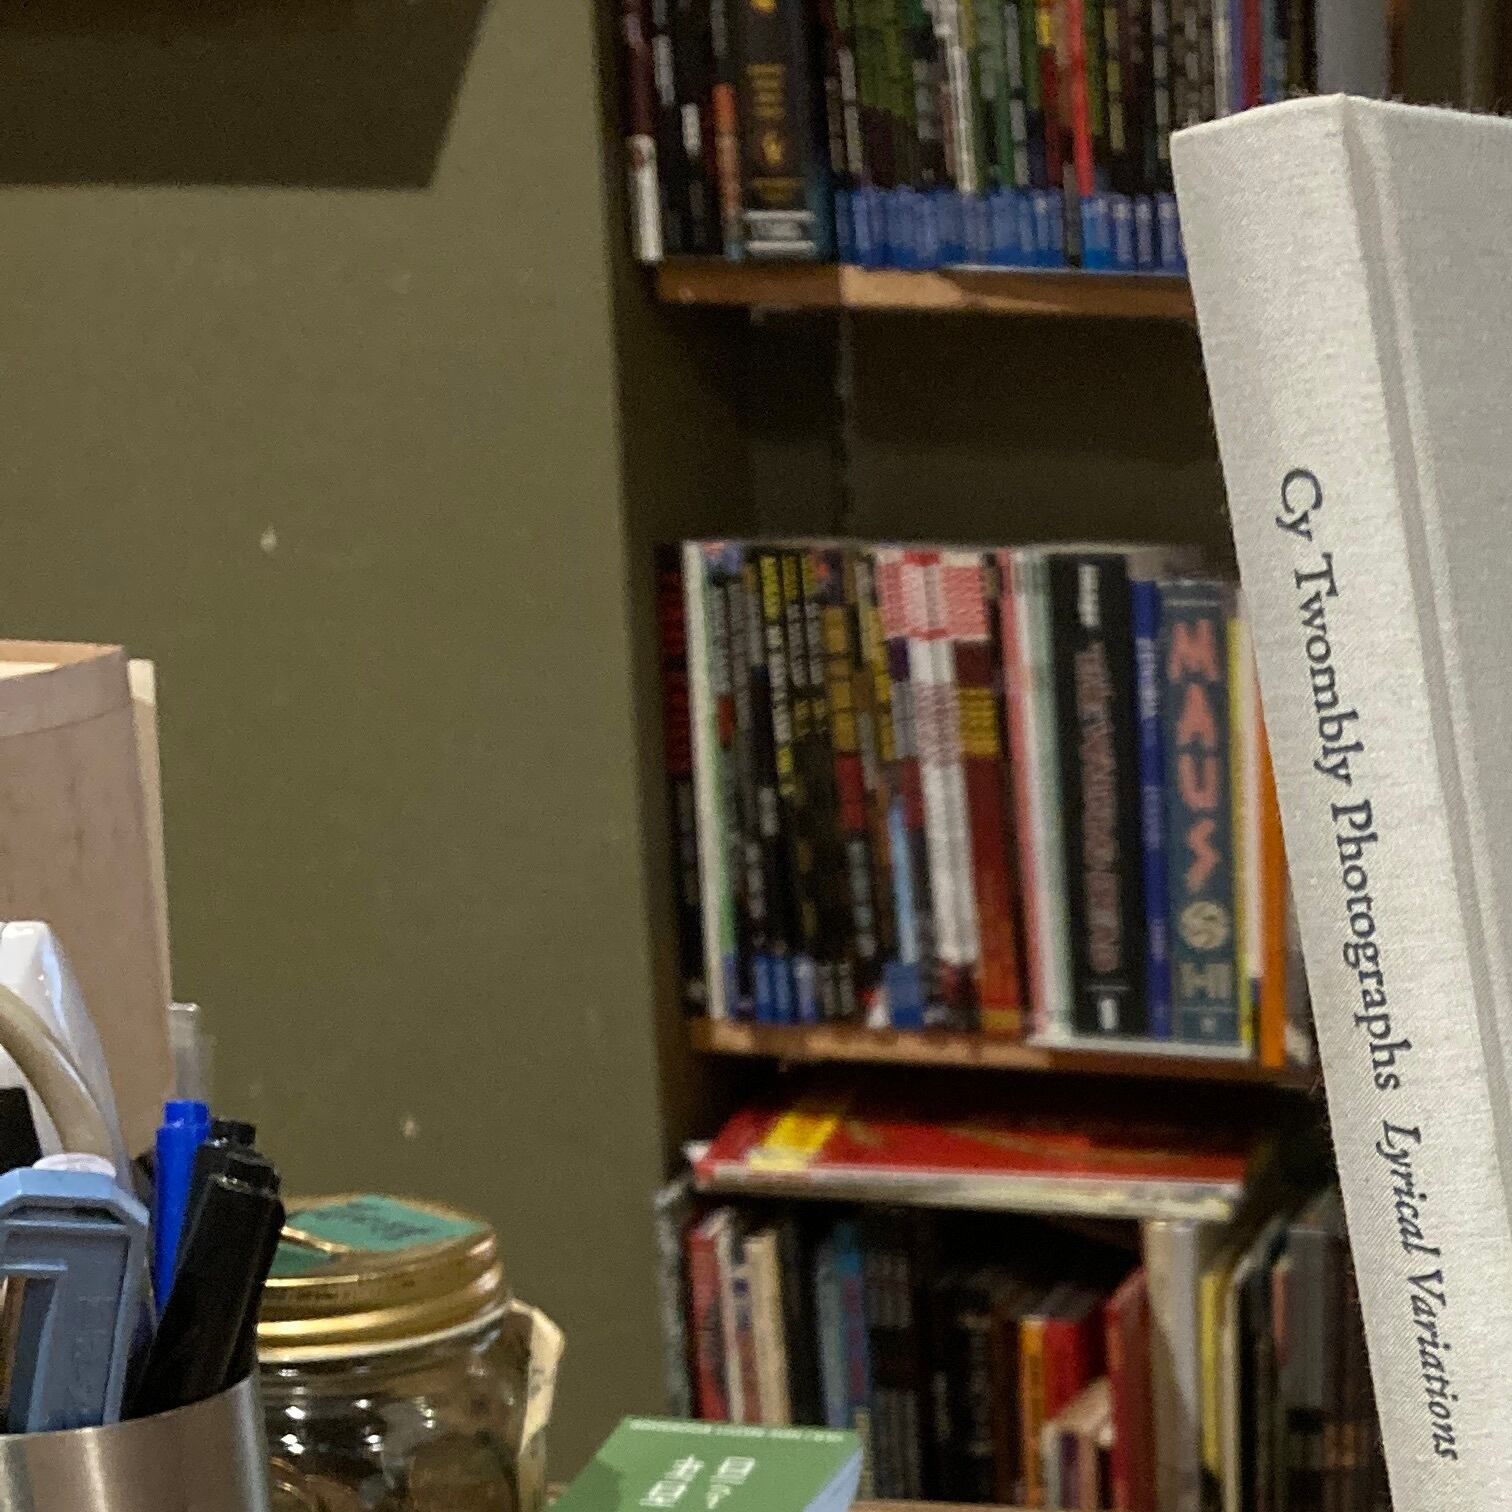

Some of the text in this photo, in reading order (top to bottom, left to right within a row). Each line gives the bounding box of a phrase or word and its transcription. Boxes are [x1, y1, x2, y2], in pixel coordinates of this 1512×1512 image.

[1275, 466, 1413, 1092] Cy Twombly Photographs
[1375, 1118, 1460, 1462] Lyrical Variations
